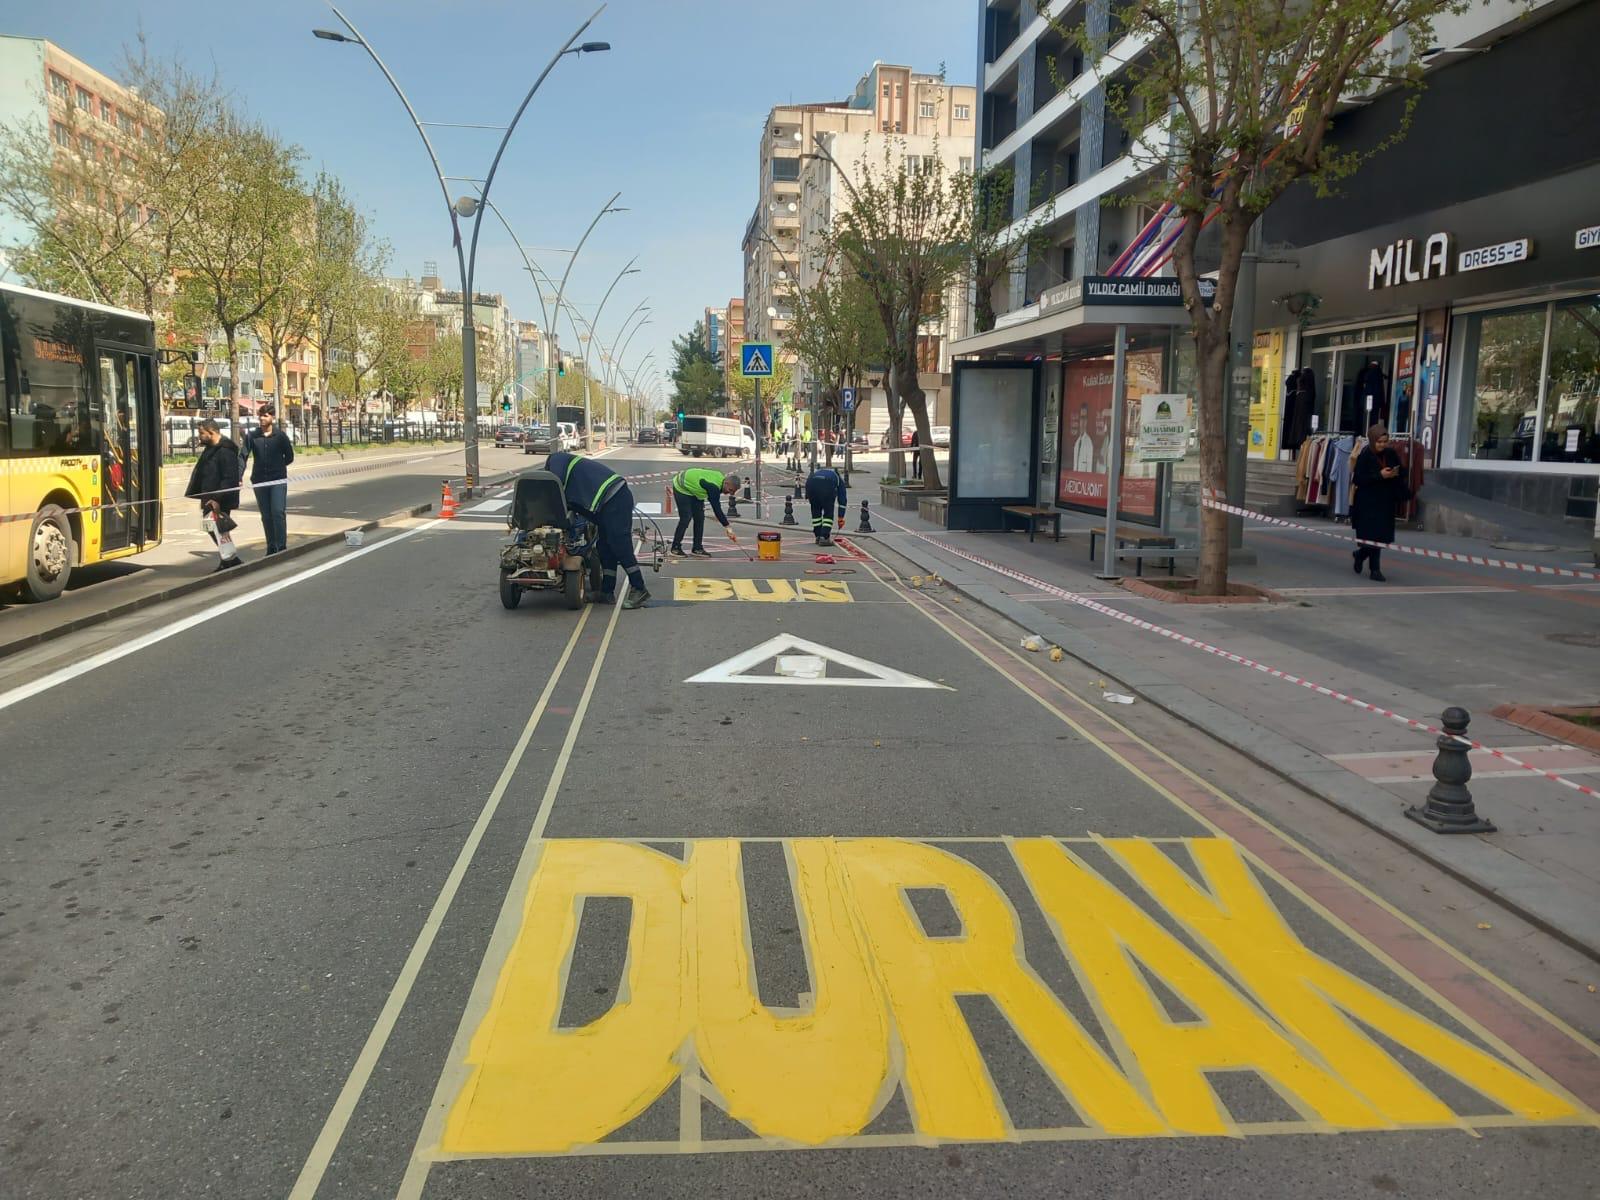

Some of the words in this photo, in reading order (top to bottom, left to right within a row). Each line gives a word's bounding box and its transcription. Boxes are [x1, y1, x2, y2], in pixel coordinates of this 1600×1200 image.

[1368, 232, 1448, 290] MİLA
[1464, 242, 1522, 268] DRESS-2
[1088, 282, 1117, 295] YILDIZ
[1119, 281, 1145, 296] CAMİİ
[1147, 282, 1180, 296] DURAĞI
[844, 390, 852, 408] P
[1422, 343, 1443, 450] MİLA
[672, 577, 852, 603] BUS
[440, 836, 1578, 1155] DURAK
